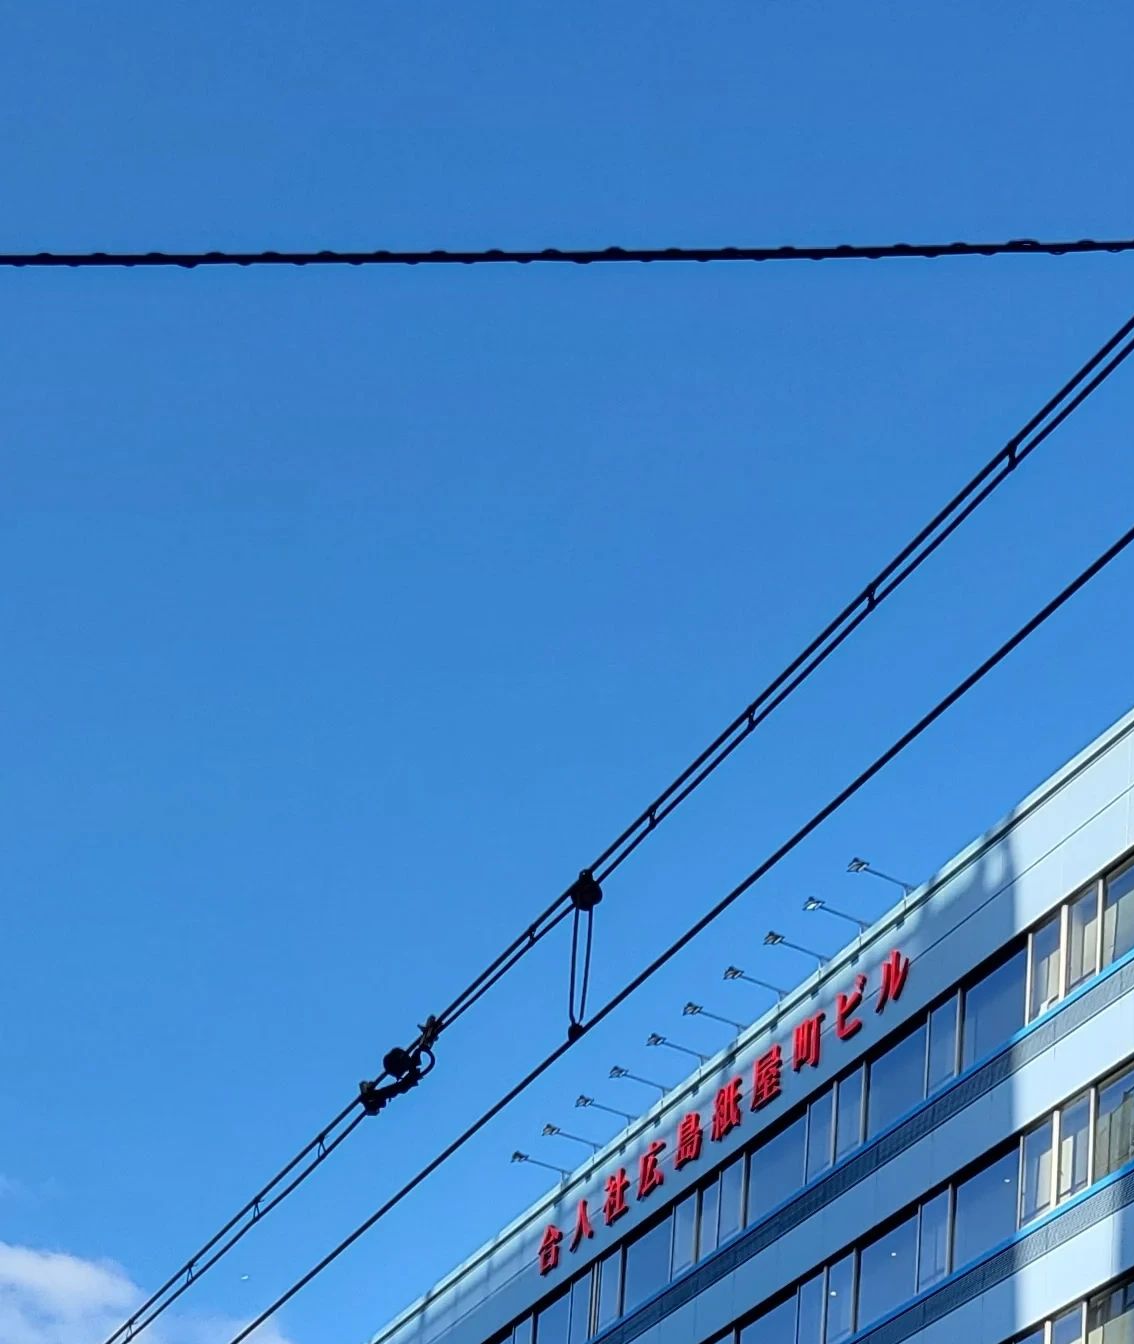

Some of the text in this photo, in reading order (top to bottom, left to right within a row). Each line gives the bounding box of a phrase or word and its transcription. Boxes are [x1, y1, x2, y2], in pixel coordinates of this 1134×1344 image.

[538, 948, 909, 1276] 合人社広島紙屋町ビル
